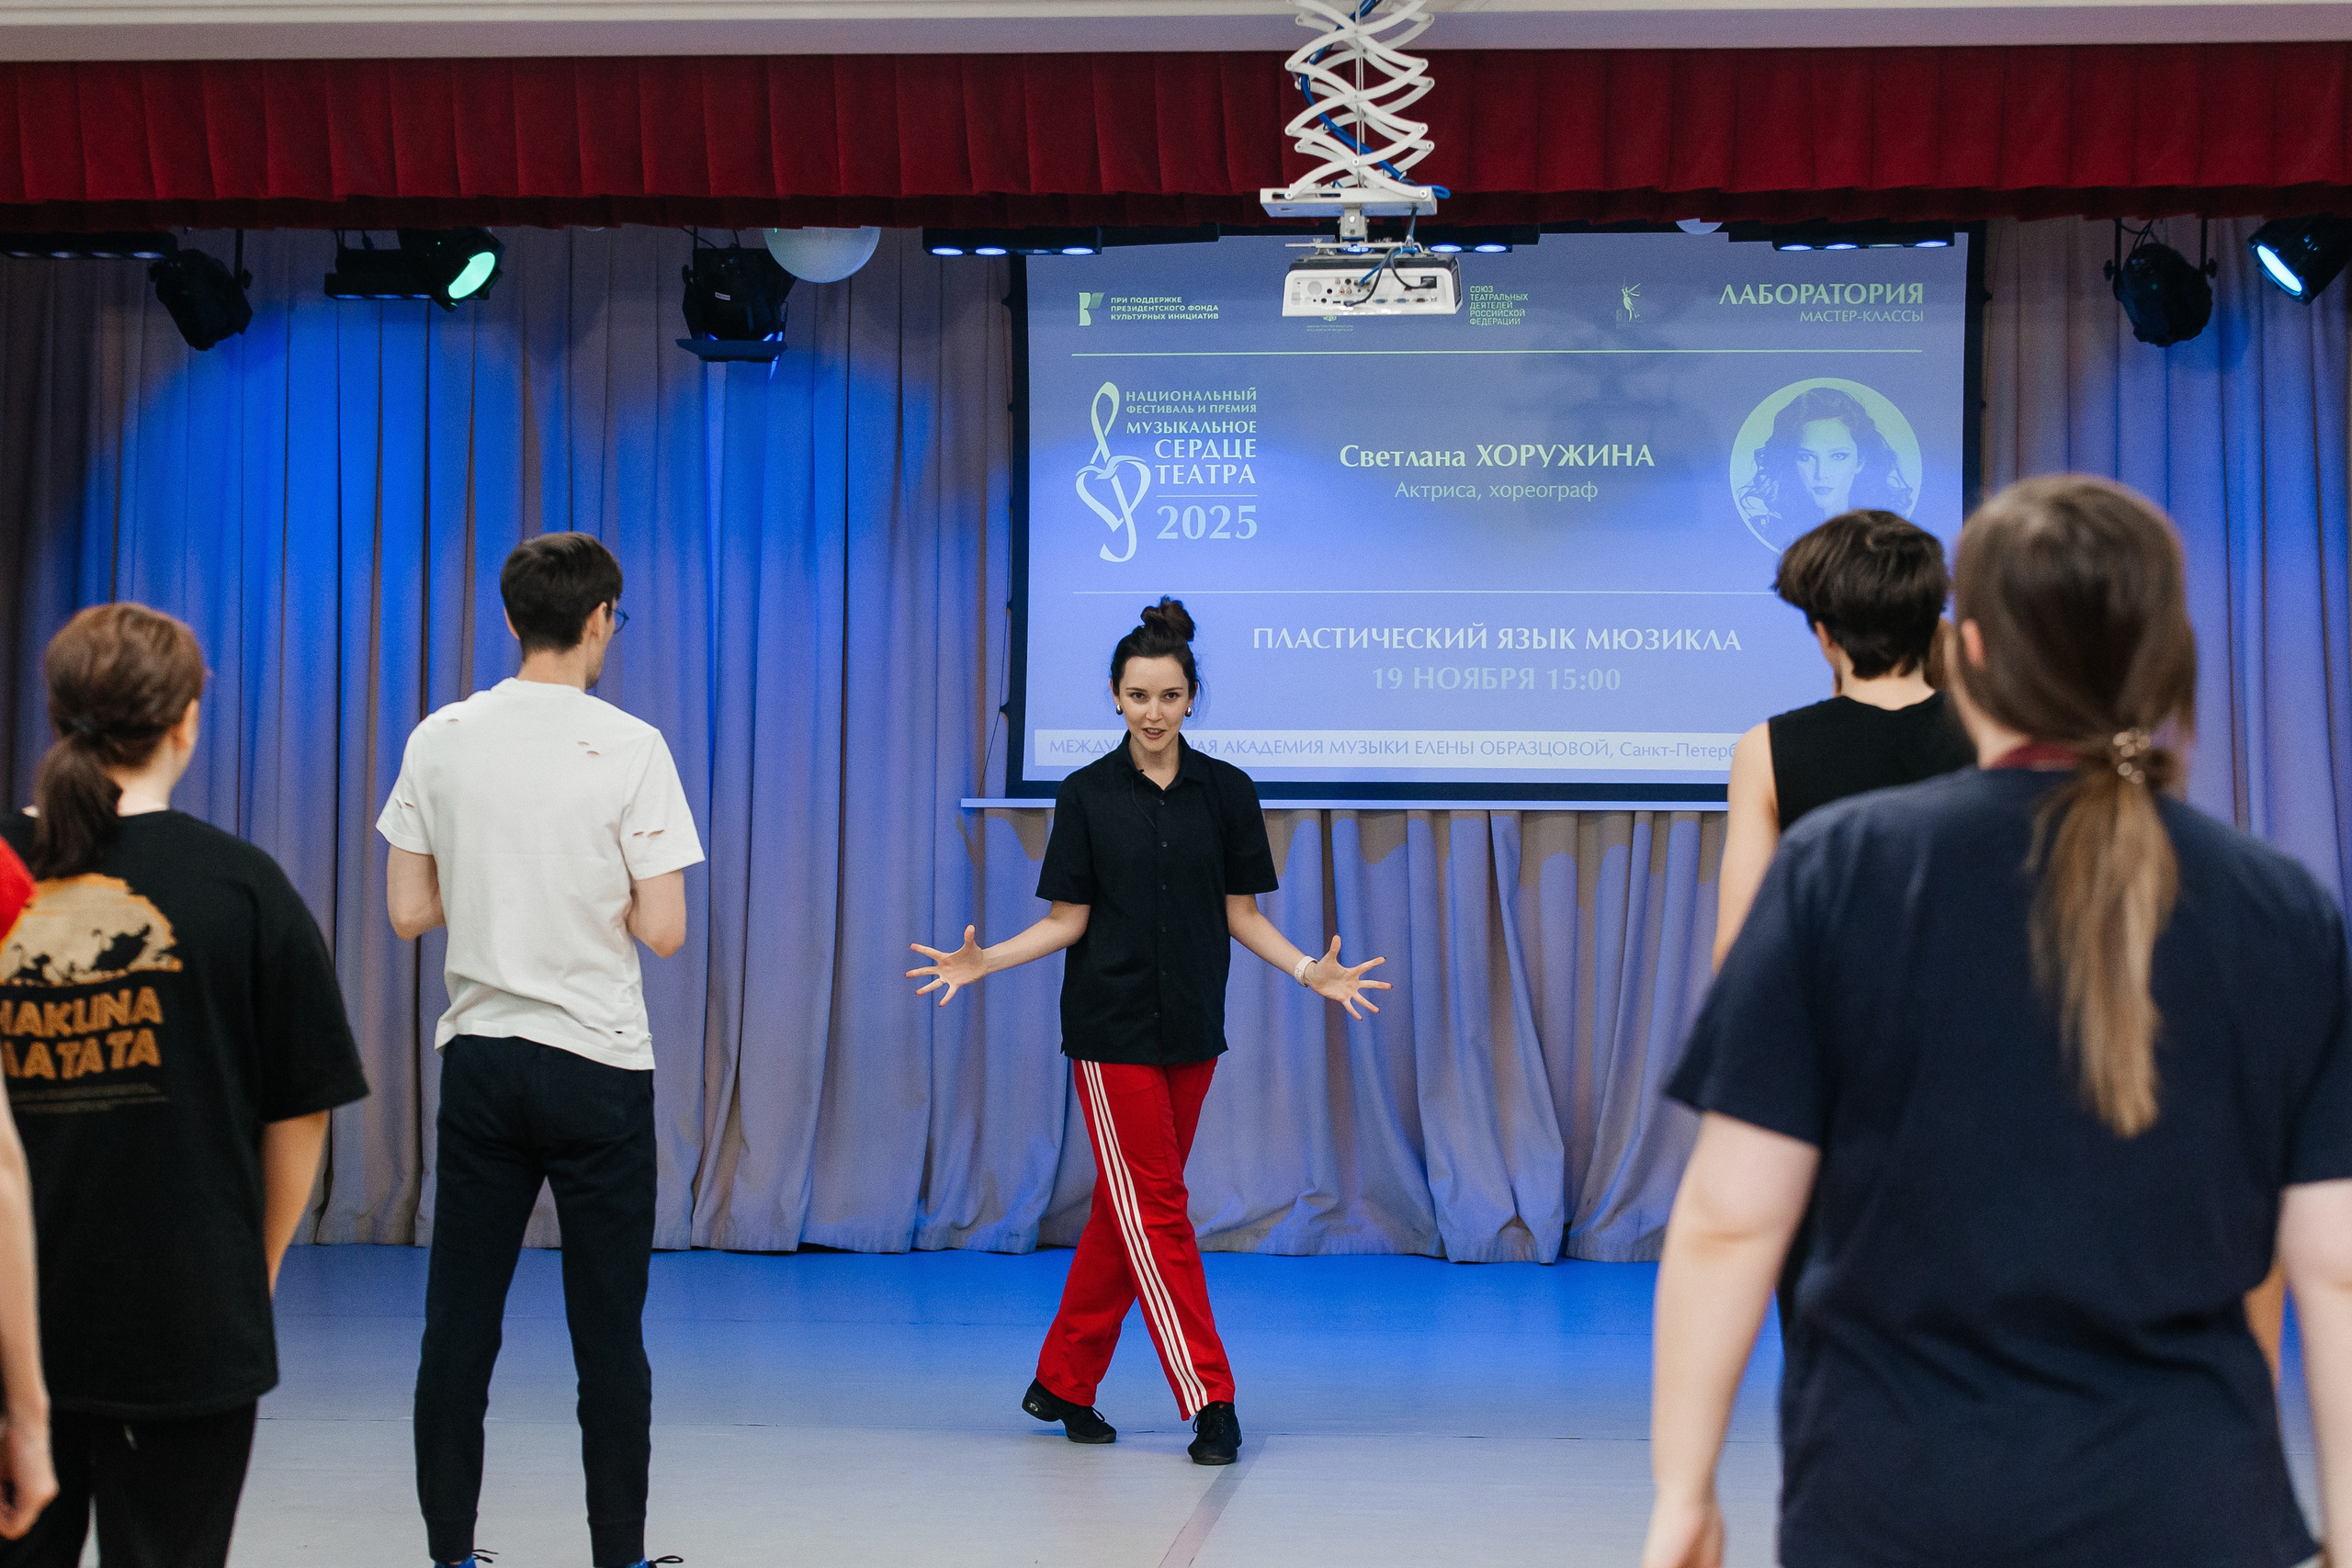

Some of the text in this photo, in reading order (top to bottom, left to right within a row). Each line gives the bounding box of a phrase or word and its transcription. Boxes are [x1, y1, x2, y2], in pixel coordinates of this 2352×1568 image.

[1719, 283, 1924, 305] ЛАБОРАТОРИЯ
[1469, 301, 1513, 310] ДЕЯТЕЛЕЙ
[1470, 309, 1526, 317] РОССИЙСКОЙ
[1799, 310, 1924, 322] МАСТЕР-КЛАССЫ
[1470, 318, 1521, 326] ФЕДЕРАЦИИ
[1125, 387, 1257, 402] НАЦИОНАЛЬНЫЙ
[1125, 404, 1257, 414] ФЕСТИВАЛЬ И ПРЕМИЯ
[1126, 421, 1257, 434] МУЗЫКАЛЬНОЕ
[1154, 438, 1257, 460] СЕРДЦЕ
[1340, 444, 1656, 468] Светлана ХОРУЖИНА
[1154, 464, 1257, 485] ТЕАТРА
[1394, 480, 1599, 502] Актриса, хореограф
[1156, 504, 1258, 540] 2025
[1253, 621, 1742, 651] ПЛАСТИЧЕСКИЙ ЯЗЫК МЮЗИКЛА
[1372, 667, 1621, 691] 19 НОЯБРЯ 15:00
[1223, 739, 1324, 756] АКАДЕМИЯ
[1329, 739, 1408, 755] МУЗЫКИ
[1415, 740, 1474, 755] ЕЛЕНЫ
[1480, 739, 1614, 759] ОБРАЗЦОВОЙ,
[1620, 741, 1736, 761] Санкт-Петерб
